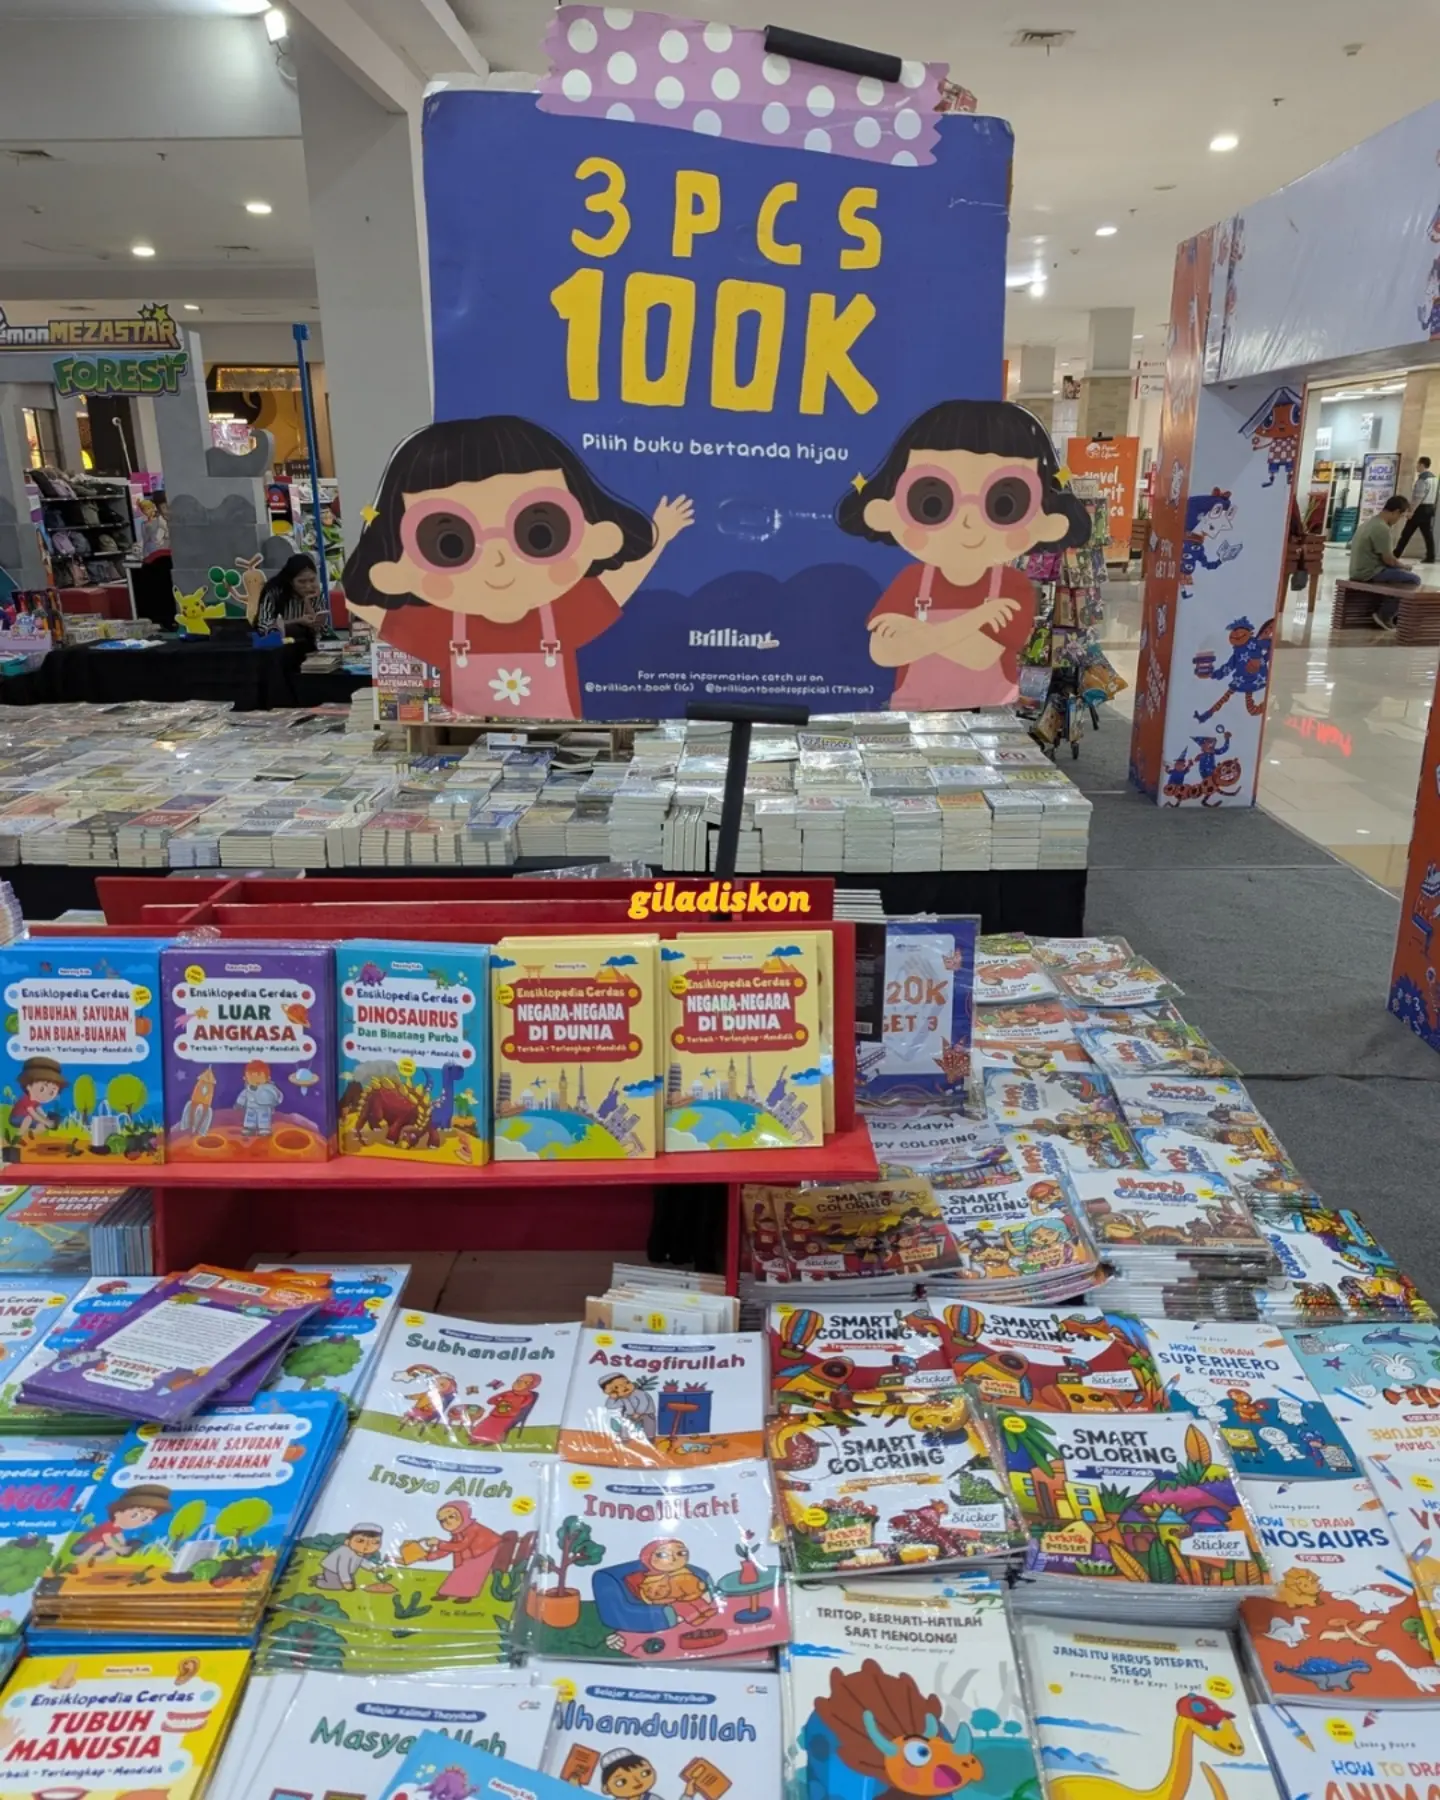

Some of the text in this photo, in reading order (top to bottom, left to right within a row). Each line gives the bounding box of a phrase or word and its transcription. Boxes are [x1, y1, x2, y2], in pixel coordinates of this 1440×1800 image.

[571, 158, 631, 257] 3
[51, 320, 179, 349] MEZASTAR
[550, 268, 878, 415] 100K
[53, 353, 187, 392] FOREST
[582, 433, 849, 464] Pilih buku bertanda hijau
[688, 628, 774, 648] Brilliant
[379, 663, 411, 675] OSN
[638, 670, 655, 680] For
[658, 672, 686, 680] more
[690, 671, 759, 682] information
[761, 673, 793, 682] catch
[674, 682, 694, 692] (IG)
[687, 979, 754, 991] Ensiklopedia
[755, 977, 791, 988] Cerdas
[22, 988, 89, 1000] Ensiklopedia
[91, 989, 130, 999] Cerdas
[189, 987, 298, 1000] Ensiklopedia Cerdas
[357, 988, 459, 1004] Ensiklopedia Cerdas
[517, 987, 584, 1000] Ensiklopedia
[586, 986, 624, 997] Cerdas
[687, 993, 791, 1013] NEGARA-NEGARA
[218, 1005, 271, 1020] LUAR
[357, 1005, 459, 1028] DINOSAURUS
[517, 1003, 625, 1022] NEGARA-NEGARA
[699, 1014, 780, 1031] DI DUNIA
[29, 1026, 127, 1042] DAN BUAH-BUAHAN
[193, 1025, 297, 1041] ANGKASA
[358, 1027, 459, 1043] Dan Binatang Purba
[529, 1024, 613, 1040] DI DUNIA
[900, 1133, 977, 1149] COLORING
[816, 1198, 892, 1213] COLORING
[825, 1191, 875, 1204] SMART
[949, 1191, 1009, 1205] SMART
[940, 1197, 1029, 1216] COLORING
[335, 1286, 375, 1294] Cerdas
[829, 1315, 893, 1327] SMART
[993, 1314, 1054, 1331] SMART
[816, 1328, 913, 1340] COLORING
[982, 1324, 1075, 1343] COLORING
[405, 1332, 556, 1361] Subhanallah
[1168, 1343, 1197, 1353] HOW
[1220, 1347, 1255, 1356] DRAW
[588, 1349, 745, 1373] Astagfirullah
[1158, 1352, 1280, 1371] SUPERHERO
[1091, 1375, 1129, 1384] Sticker
[1184, 1366, 1266, 1379] & CARTOON
[162, 1422, 291, 1434] Ensiklopedia Cerdas
[842, 1434, 916, 1456] SMART
[1073, 1429, 1147, 1446] SMART
[1058, 1445, 1177, 1464] COLORING
[1394, 1441, 1436, 1452] DRAW
[147, 1454, 272, 1469] DAN BUAH-BUAHAN
[827, 1448, 945, 1475] COLORING
[42, 1467, 91, 1478] Cerdas
[368, 1464, 513, 1499] Insya Allah
[952, 1511, 999, 1524] Sticker
[1286, 1517, 1309, 1528] TO
[1312, 1517, 1355, 1528] DRAW
[1192, 1539, 1241, 1550] Sticker
[1260, 1528, 1390, 1549] NOSAURS
[817, 1607, 982, 1628] TRITOP, BERHATI-HATILAH
[844, 1625, 958, 1644] SAAT MENOLONG!
[1053, 1646, 1208, 1670] JANJI ITU HARUS DITEPATI,
[1110, 1664, 1152, 1678] STEGO!
[30, 1690, 194, 1707] Ensiklopedia Cerdas
[594, 1688, 627, 1698] Belajar
[628, 1691, 663, 1700] Kalimat
[364, 1705, 478, 1721] Belajar Kalimat Thayyibah
[48, 1709, 155, 1734] TUBUH
[310, 1716, 418, 1759] Masya
[4, 1735, 162, 1762] MANUSIA
[41, 1766, 162, 1779] Terlengkap Mendidik
[1331, 1760, 1375, 1776] HOW
[1378, 1762, 1405, 1777] TO
